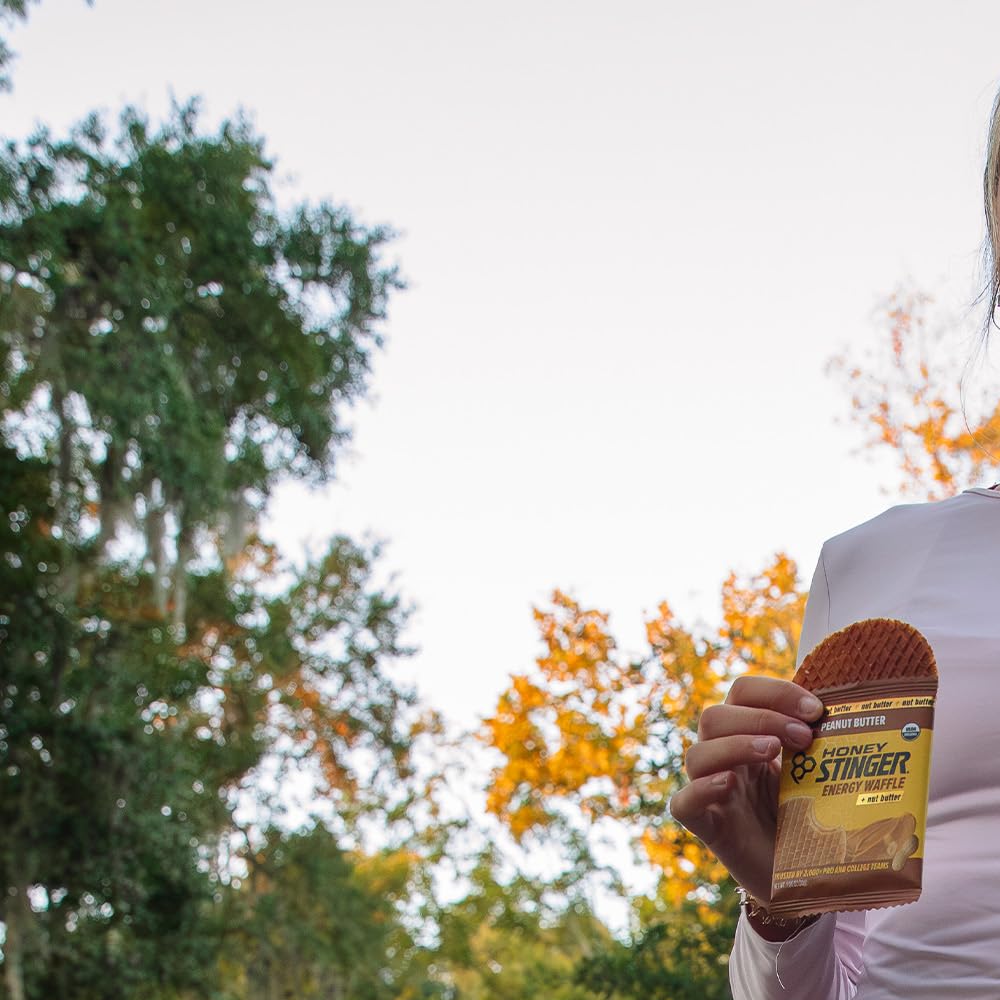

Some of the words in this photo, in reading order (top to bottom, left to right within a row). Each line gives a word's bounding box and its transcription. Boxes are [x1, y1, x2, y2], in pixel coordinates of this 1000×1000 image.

[873, 701, 893, 709] butter
[821, 718, 852, 732] PEANUT
[853, 715, 886, 728] BUTTER
[822, 742, 888, 758] HONEY
[822, 781, 863, 797] ENERGY
[864, 777, 906, 792] WAFFLE
[867, 794, 879, 803] nut
[880, 793, 902, 802] butter
